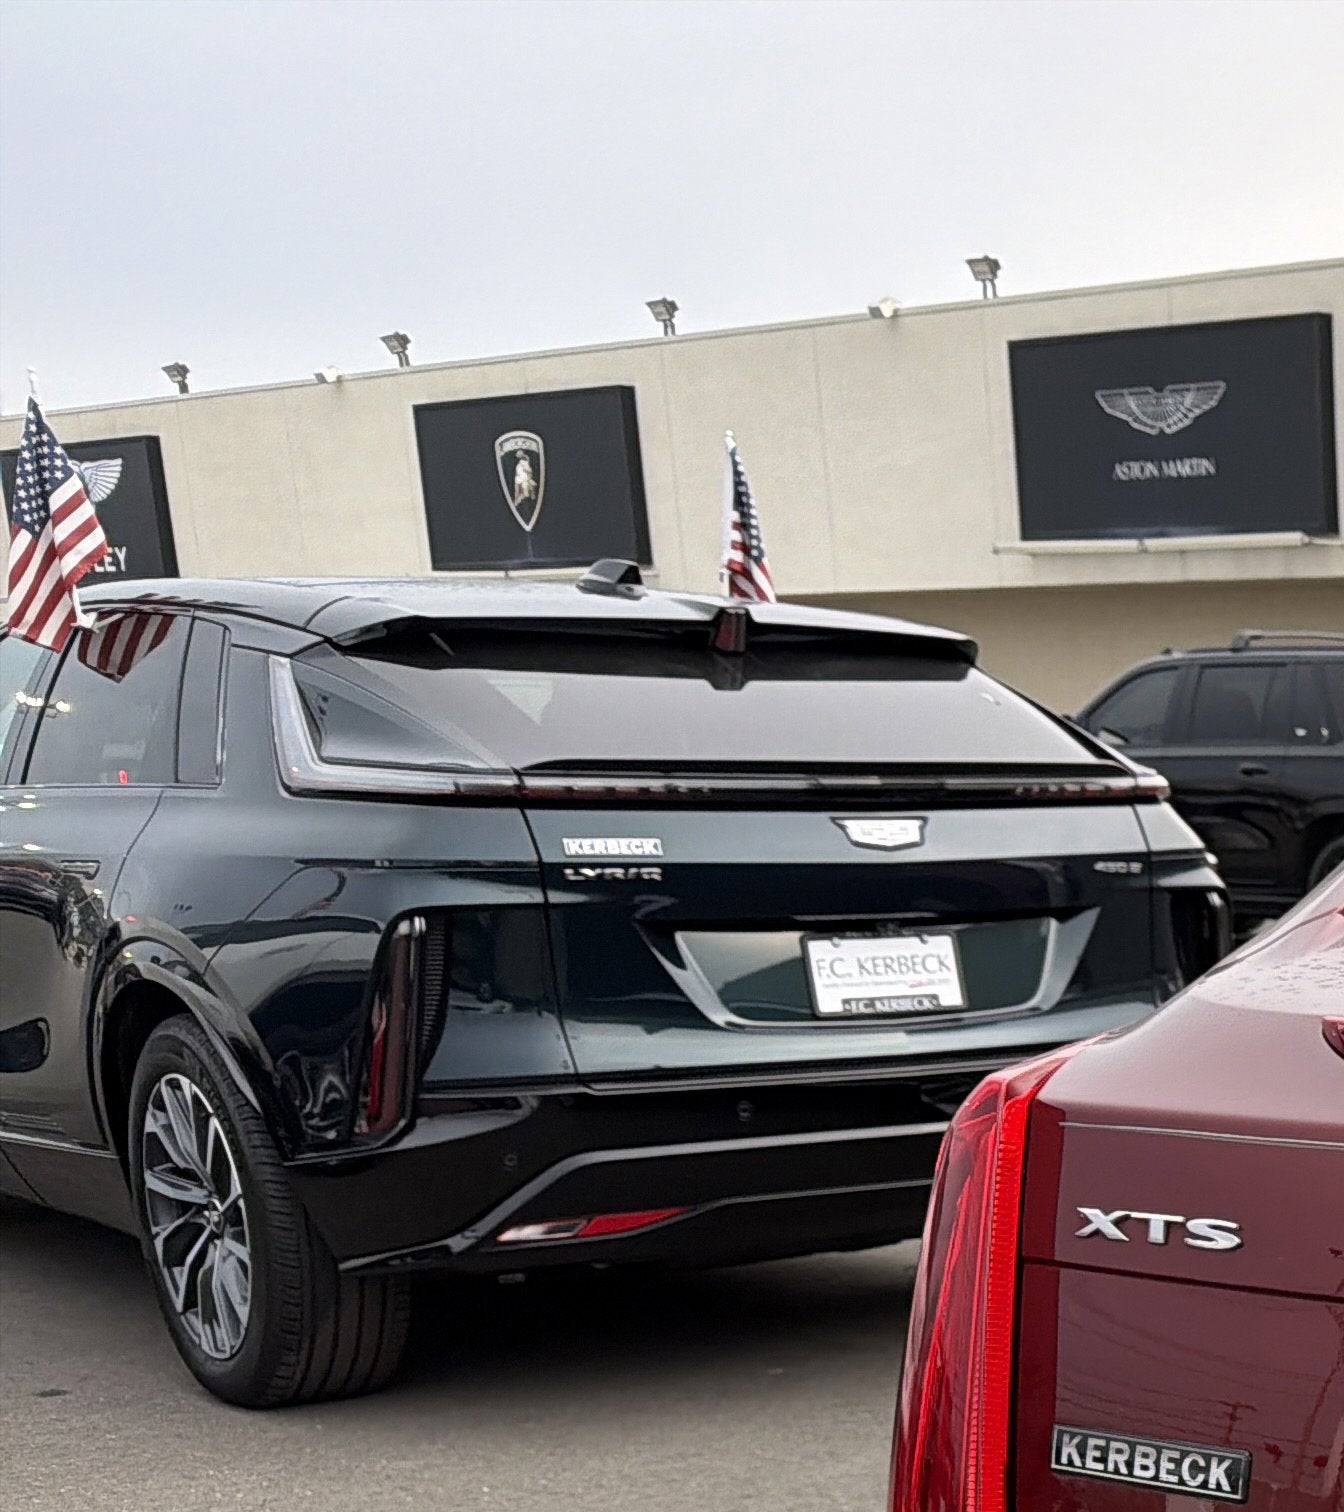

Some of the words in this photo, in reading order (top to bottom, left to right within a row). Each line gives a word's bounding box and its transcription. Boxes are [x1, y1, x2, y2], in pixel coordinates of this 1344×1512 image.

[1112, 460, 1160, 481] ASTON
[1161, 457, 1216, 478] MARTIN
[566, 839, 658, 856] KERBECK
[856, 953, 952, 977] KERBECK
[1075, 1206, 1242, 1250] XTS
[1060, 1432, 1233, 1492] KERBECK
